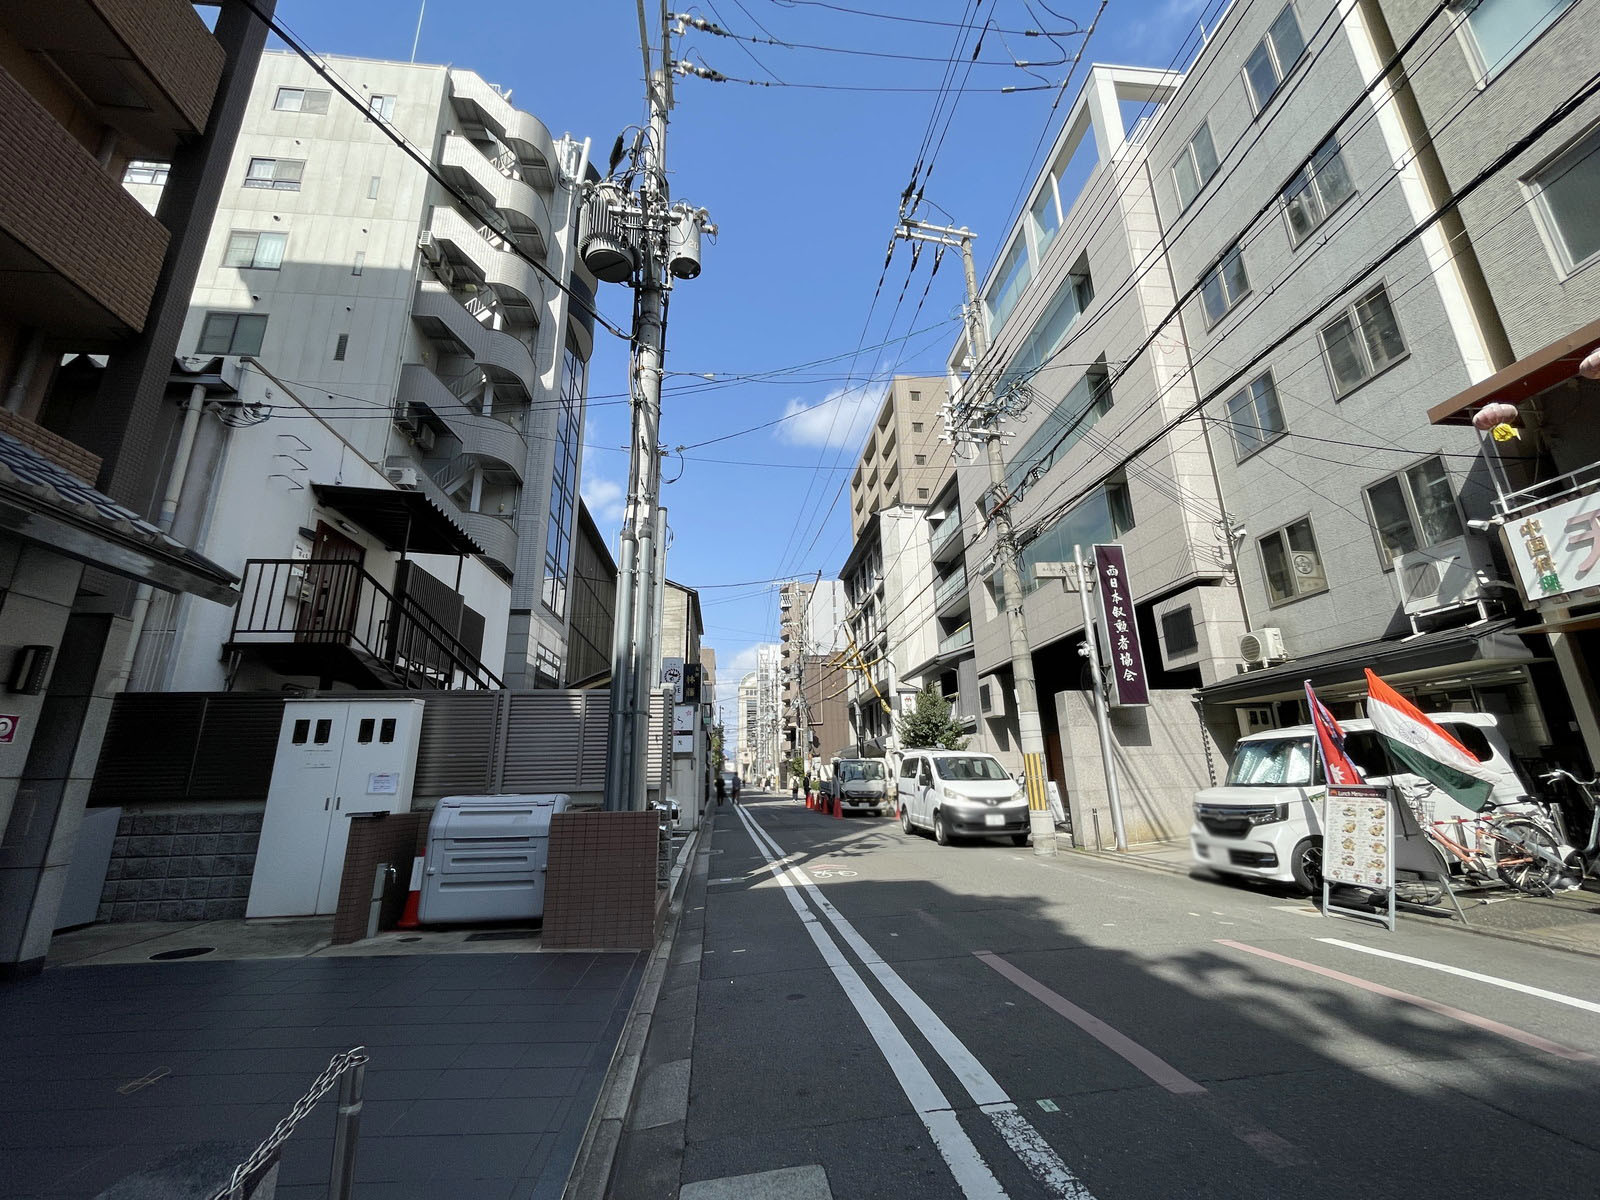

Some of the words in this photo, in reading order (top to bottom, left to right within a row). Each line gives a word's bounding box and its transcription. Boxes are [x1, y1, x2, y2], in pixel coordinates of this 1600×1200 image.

[1105, 565, 1138, 682] 西日本叙勲者協会
